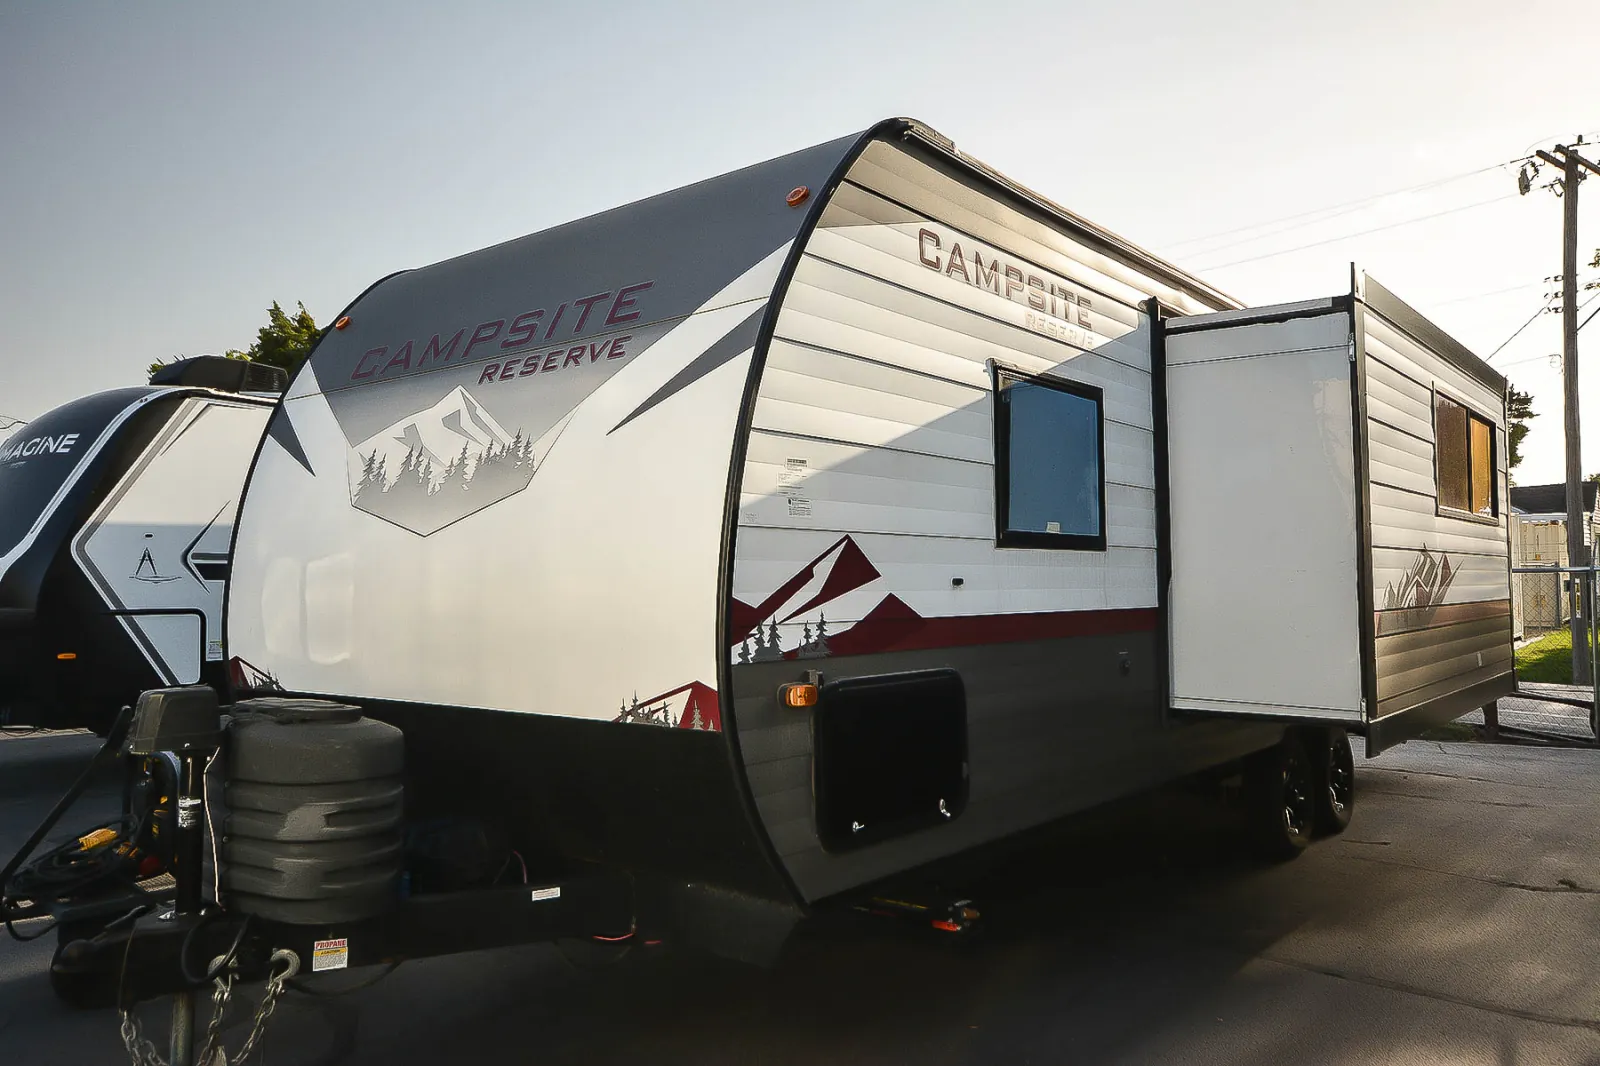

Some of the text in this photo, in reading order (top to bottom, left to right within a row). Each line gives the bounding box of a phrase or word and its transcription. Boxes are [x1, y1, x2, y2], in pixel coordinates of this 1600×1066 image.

[918, 227, 1093, 330] CAMPSITE
[351, 280, 655, 381] CAMPSITE
[478, 335, 633, 386] RESERVE
